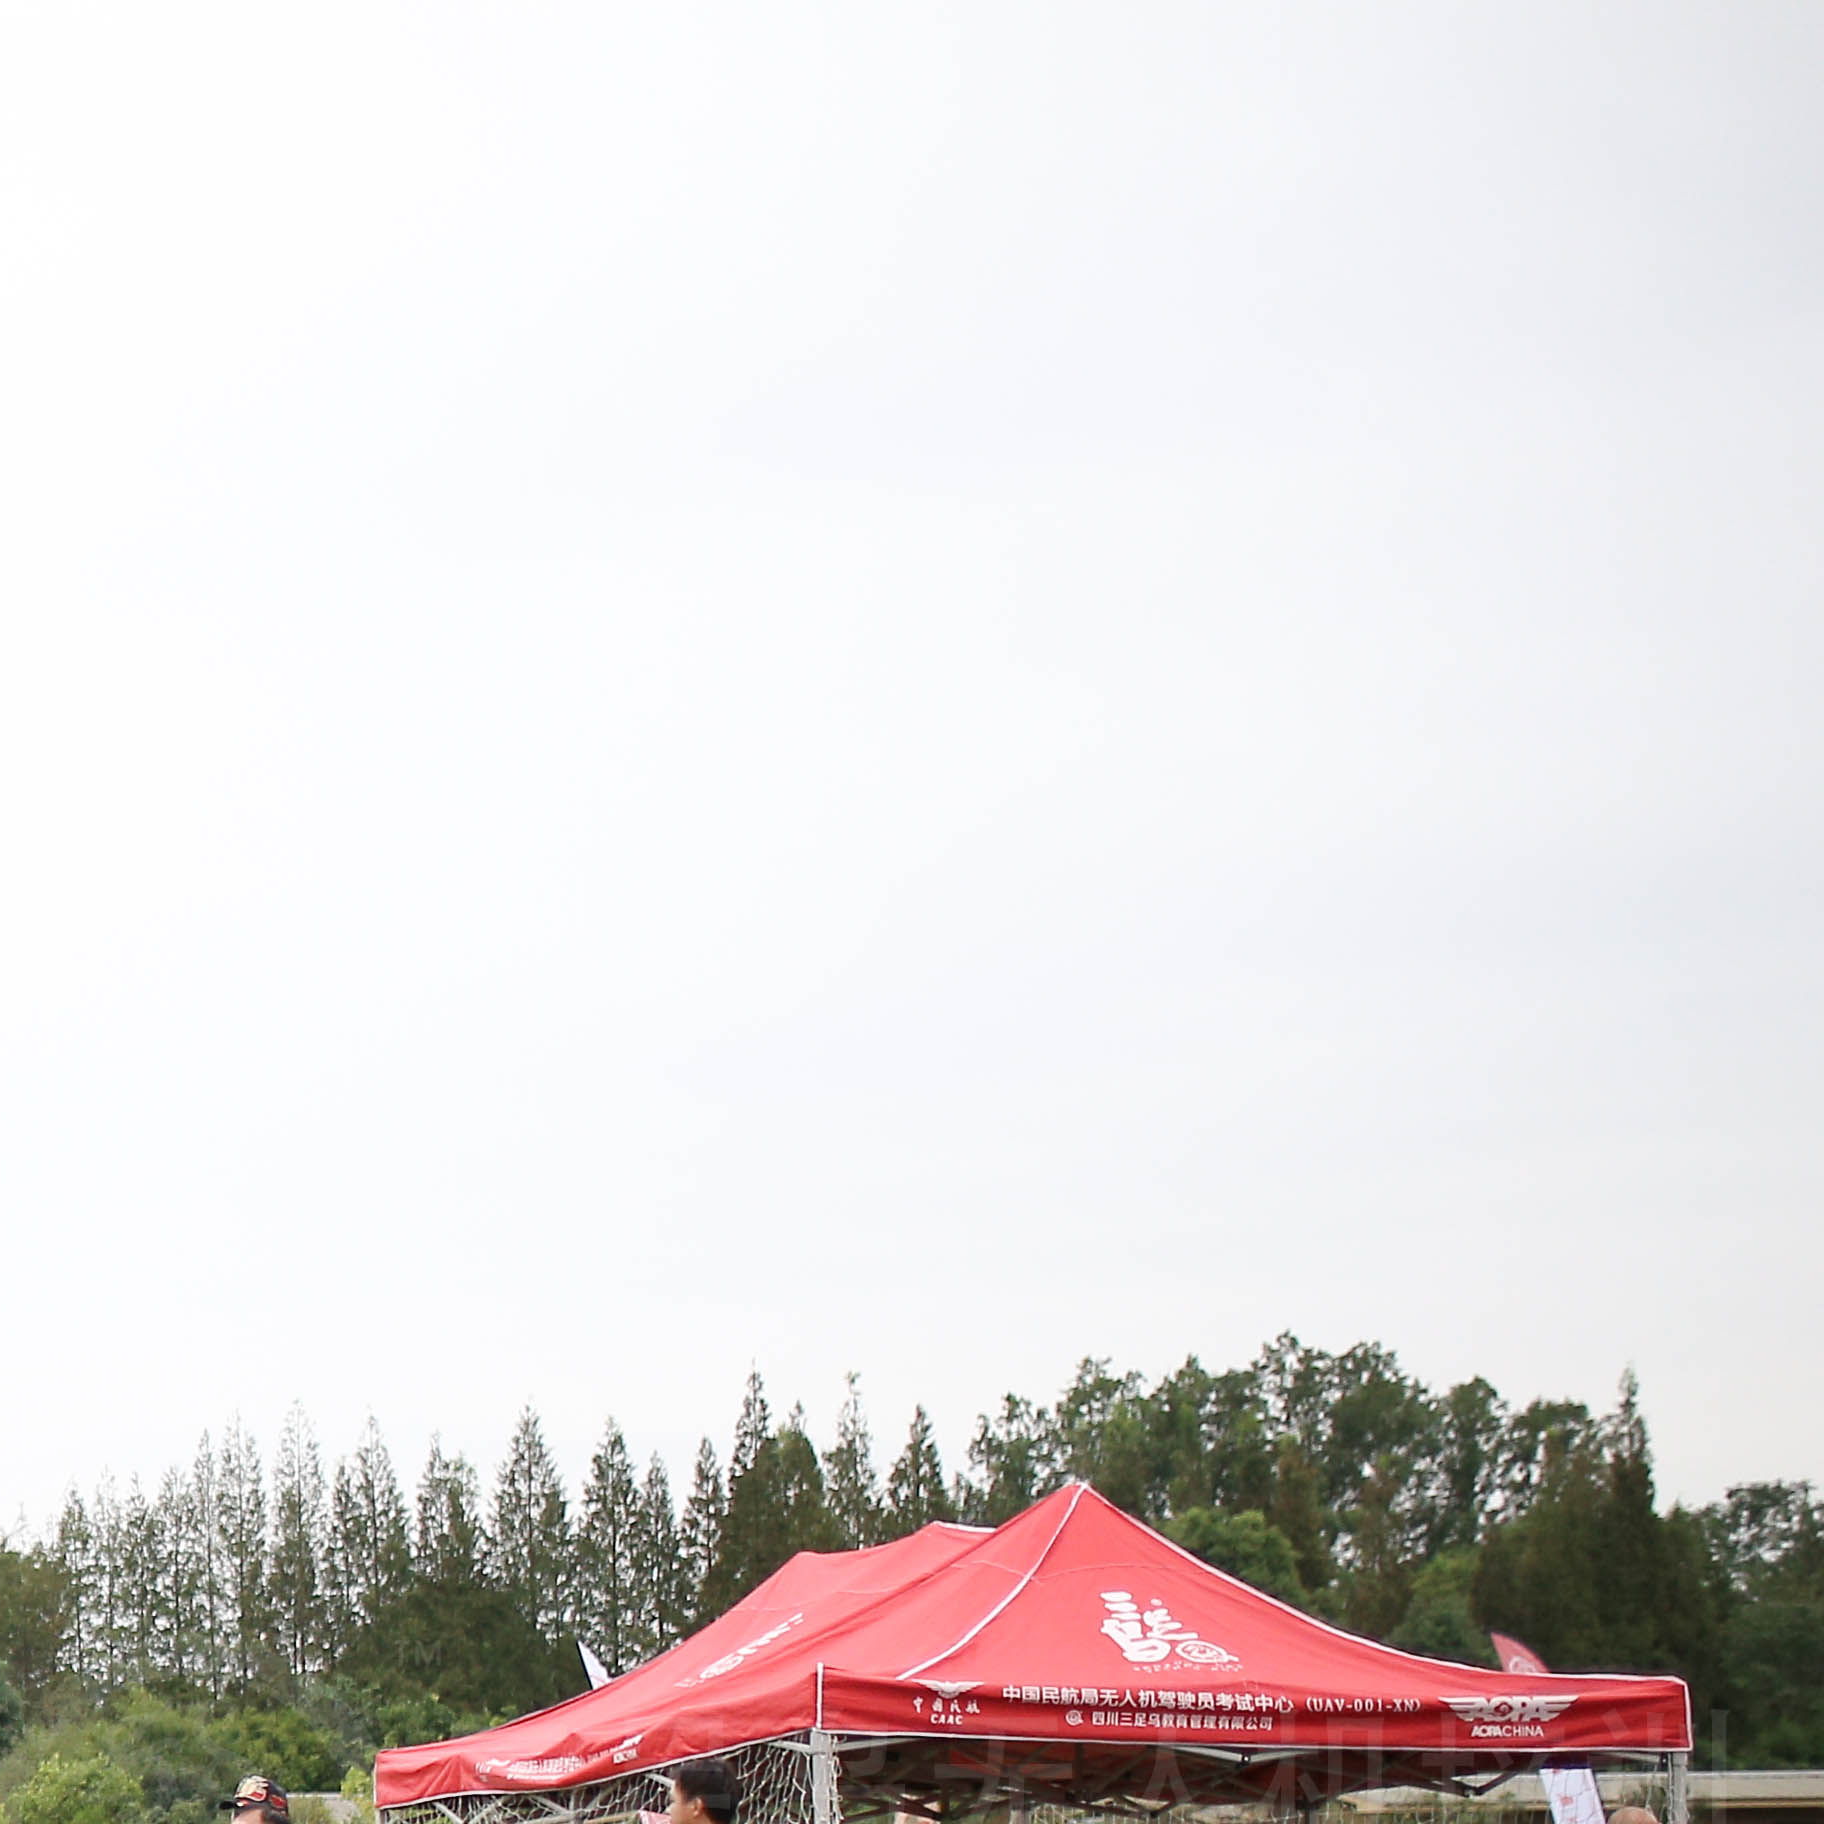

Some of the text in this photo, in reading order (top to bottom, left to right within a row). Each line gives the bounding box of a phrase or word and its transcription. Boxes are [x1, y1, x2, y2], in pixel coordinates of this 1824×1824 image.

[1002, 1685, 1294, 1714] 中国民航局无人机驾驶员考试中心
[930, 1713, 964, 1726] CAAC
[1091, 1711, 1273, 1731] 四川三足乌教育管理有限公司
